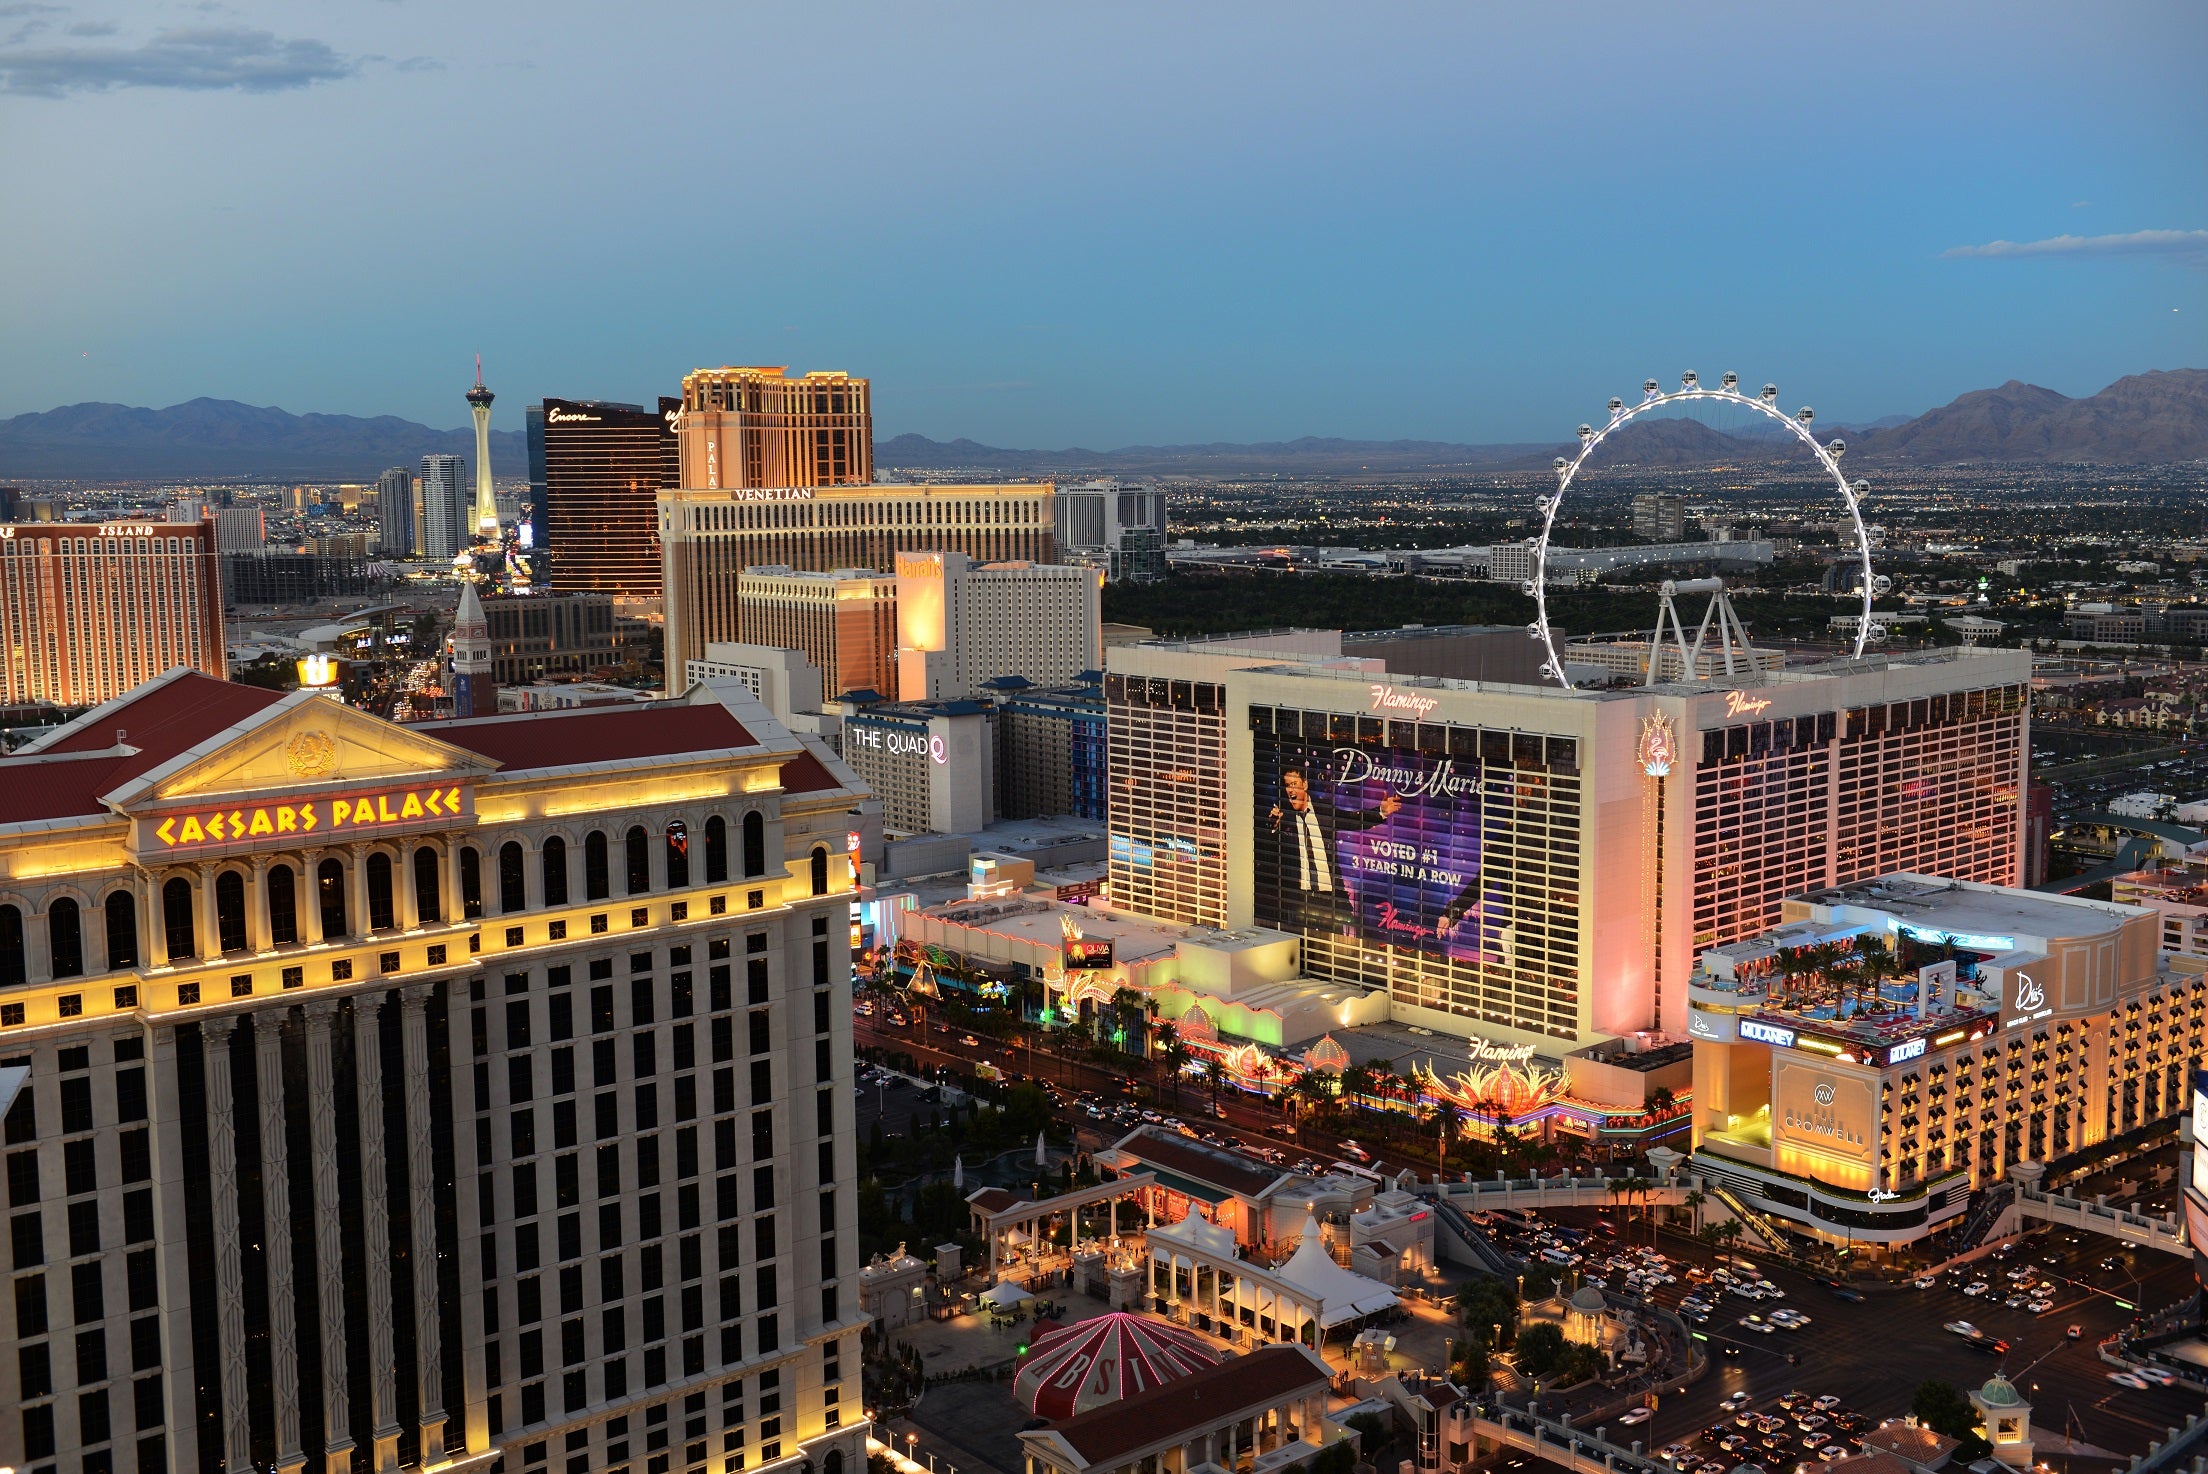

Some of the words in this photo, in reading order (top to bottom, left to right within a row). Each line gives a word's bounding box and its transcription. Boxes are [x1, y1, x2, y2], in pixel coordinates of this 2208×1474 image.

[549, 407, 602, 423] Encore
[707, 441, 718, 489] PALA
[735, 488, 812, 501] VENETIAN
[98, 526, 153, 536] ISLAND
[1370, 684, 1438, 718] Flamingo
[1725, 691, 1772, 718] Flamingo
[853, 728, 882, 748] THE
[887, 733, 929, 755] QUAD
[930, 735, 948, 764] Q
[1331, 747, 1414, 792] Donny
[1393, 759, 1487, 798] Marie
[1414, 770, 1424, 786] &
[155, 802, 318, 847] CAESARS
[332, 786, 461, 827] PALACE
[1370, 839, 1417, 861] VOTED
[1422, 848, 1438, 865] #1
[1352, 855, 1360, 869] 3
[1362, 857, 1398, 876] YEARS
[1401, 864, 1415, 878] IN
[1417, 868, 1427, 881] A
[1431, 870, 1462, 887] ROW
[1375, 901, 1435, 941] Flamingo
[1740, 1020, 1794, 1047] MULANEY
[1469, 1036, 1537, 1066] Flamingo
[1785, 1116, 1864, 1146] CROMWELL
